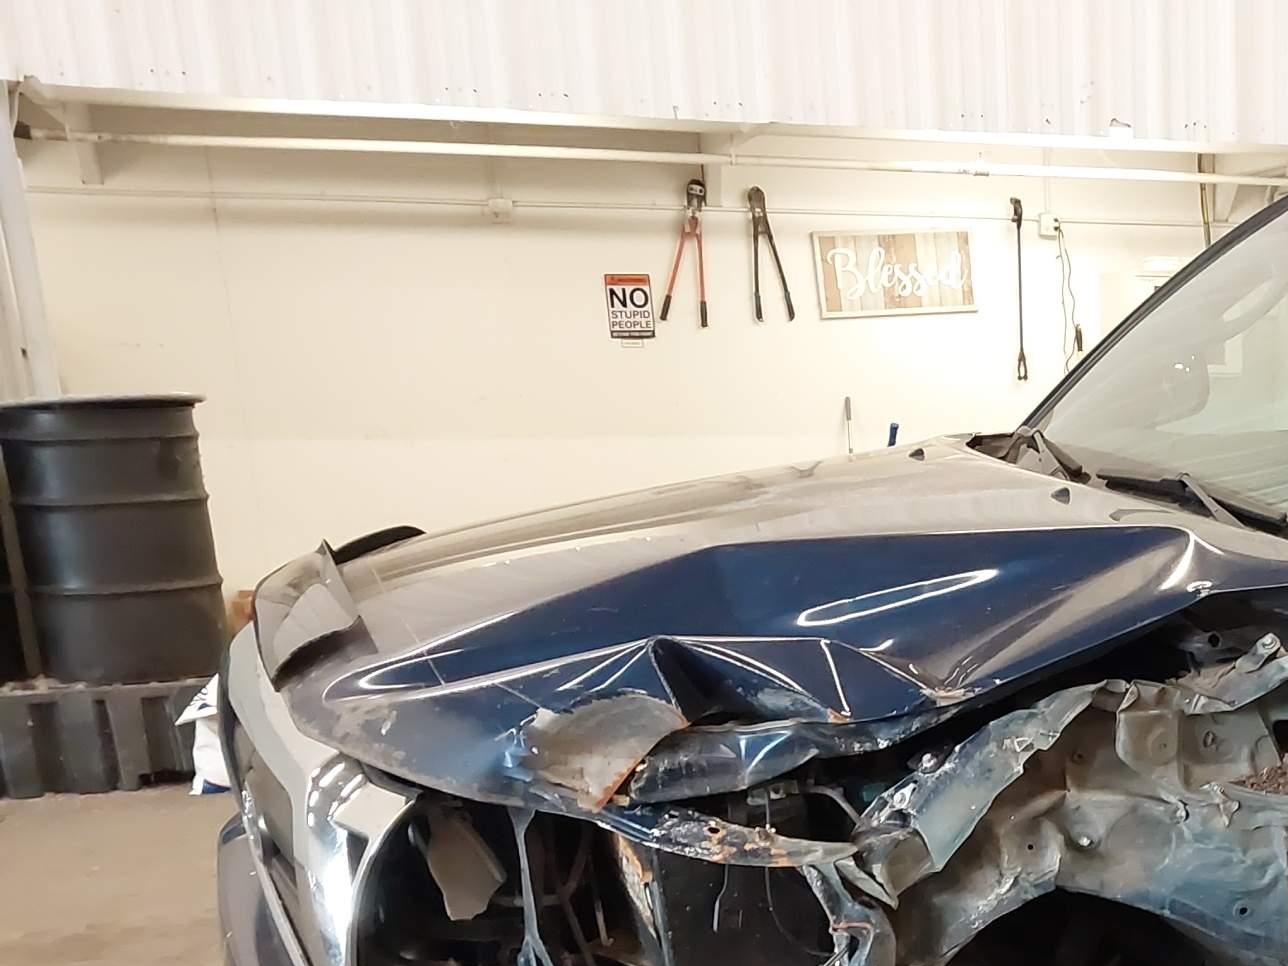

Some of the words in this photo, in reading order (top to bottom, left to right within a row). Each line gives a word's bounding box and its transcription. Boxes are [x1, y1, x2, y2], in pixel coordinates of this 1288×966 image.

[827, 247, 968, 299] Blessed
[609, 287, 649, 308] NO
[611, 310, 650, 319] STUPID
[612, 320, 652, 328] PEOPLE
